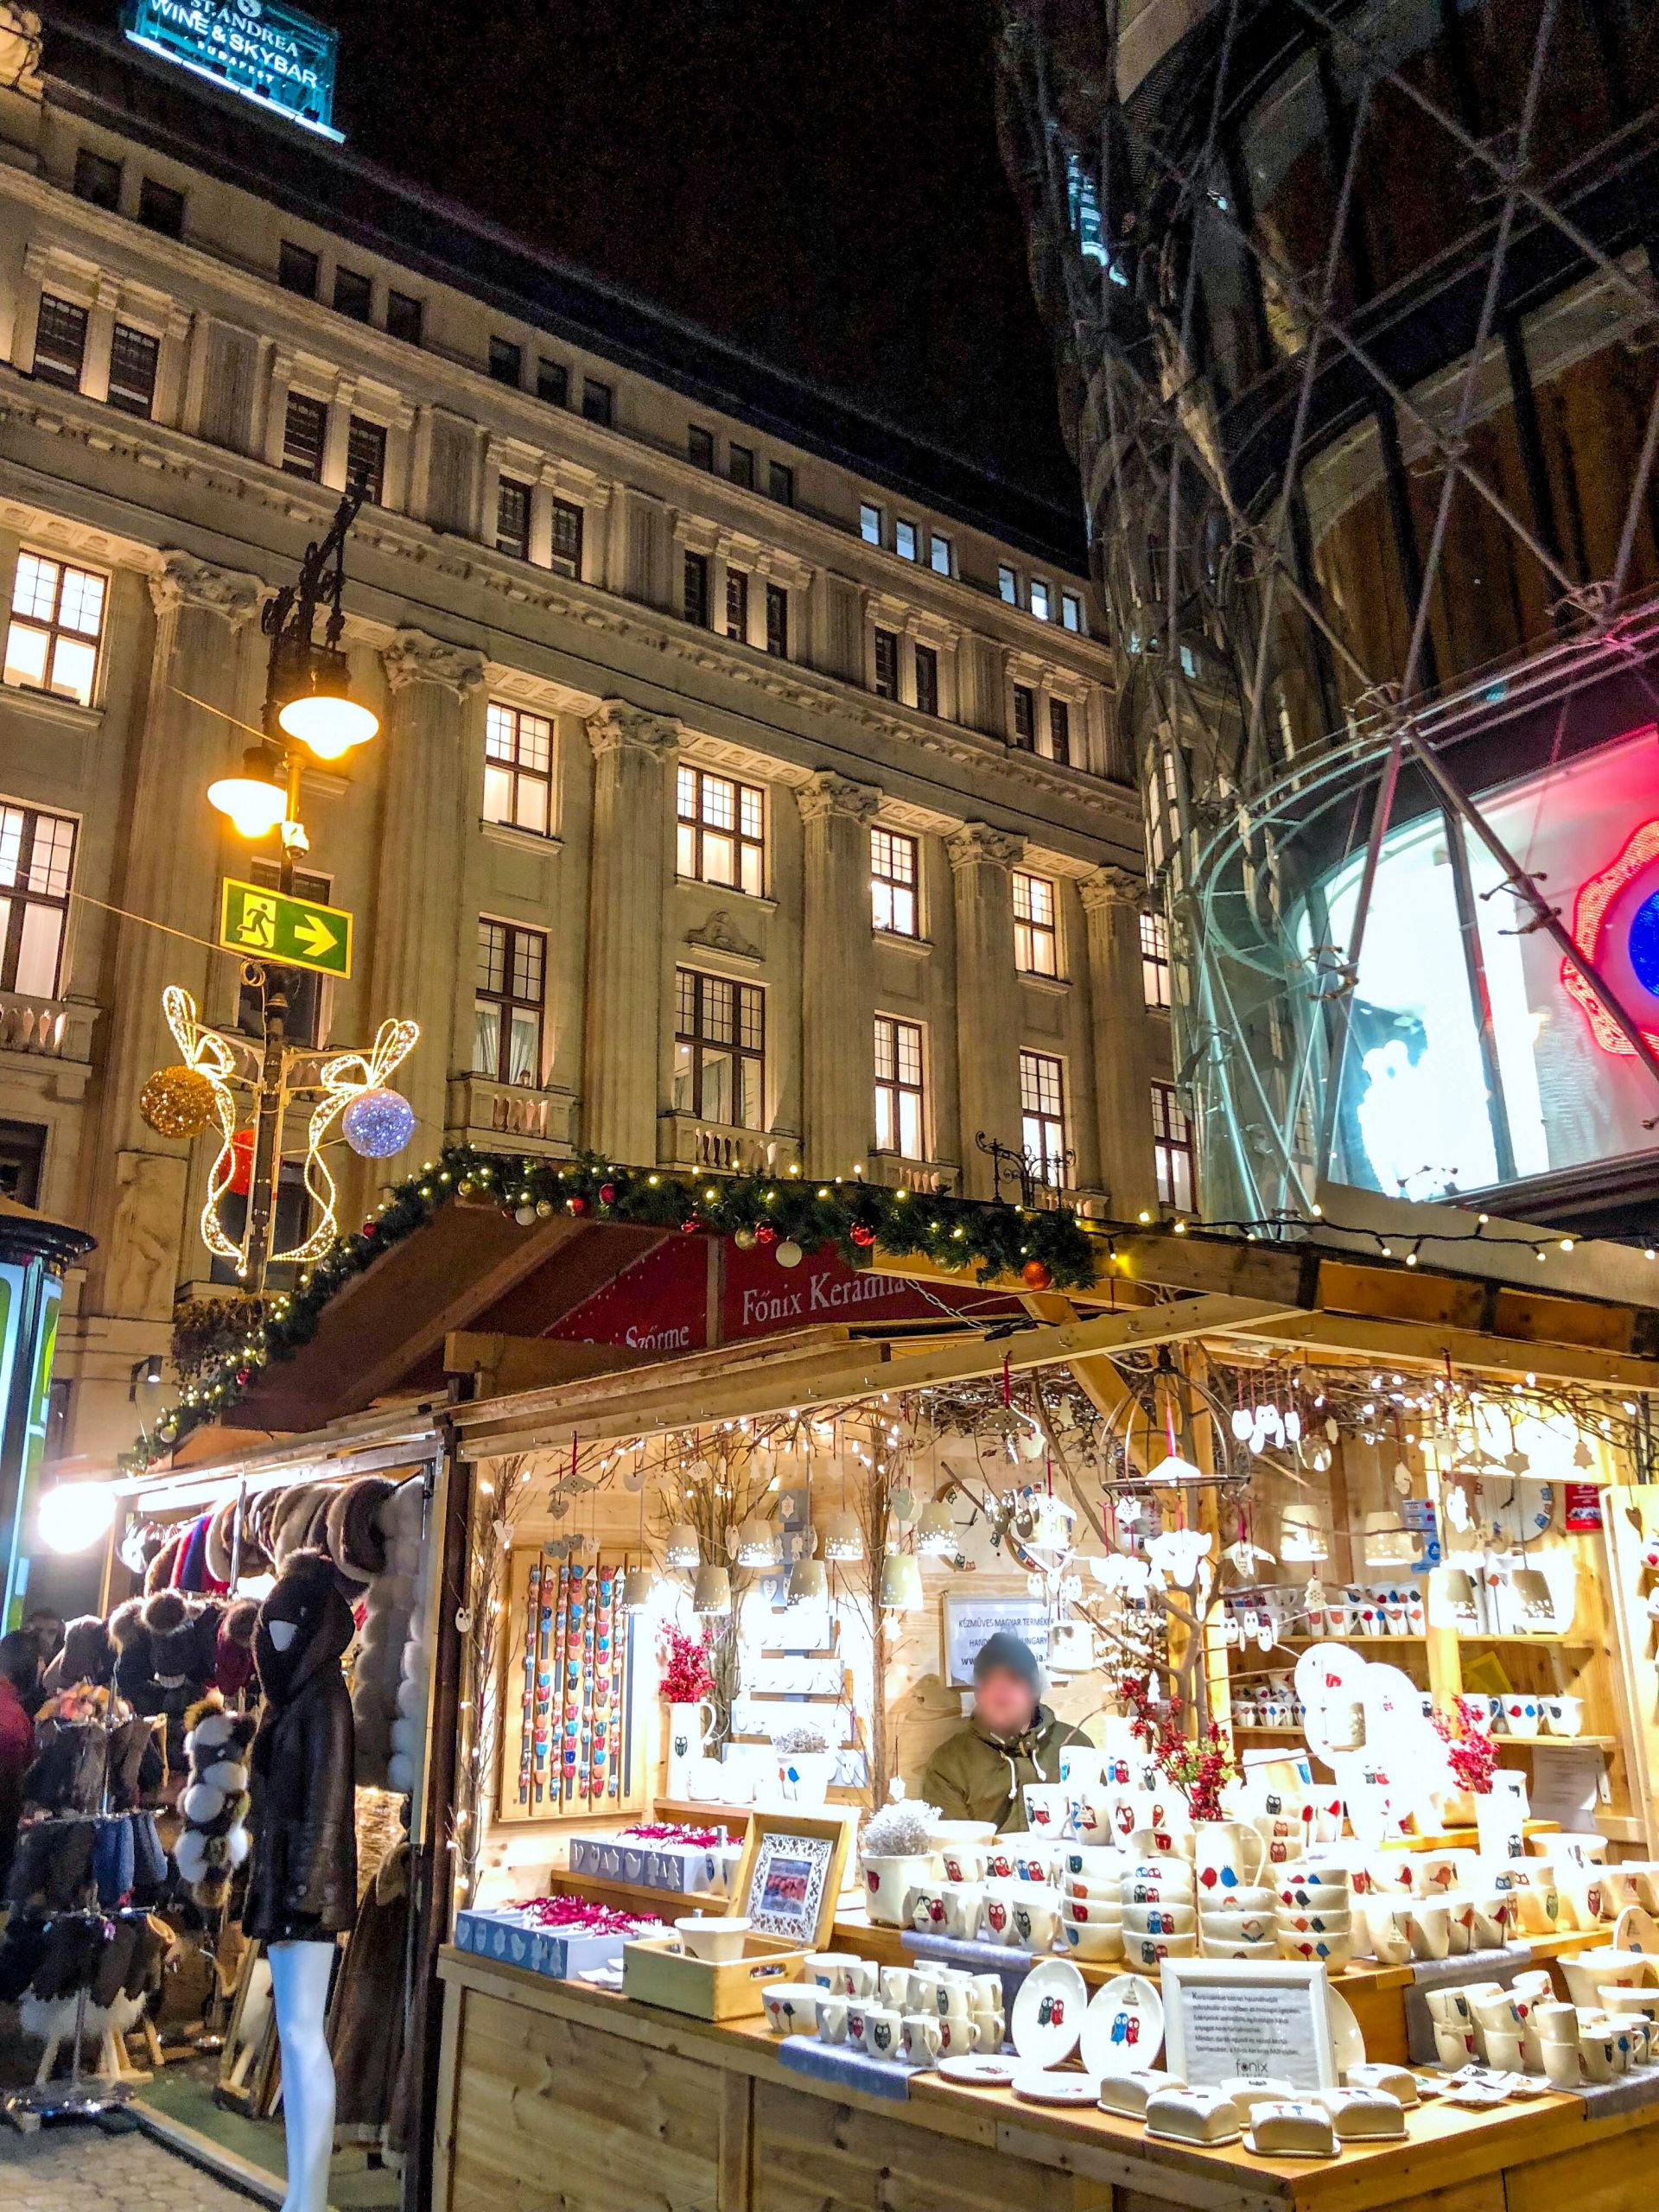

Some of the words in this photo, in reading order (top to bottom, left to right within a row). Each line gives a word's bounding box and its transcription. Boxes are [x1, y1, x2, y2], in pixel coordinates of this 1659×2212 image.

[150, 0, 210, 35] WINE
[211, 24, 226, 43] &
[229, 33, 317, 88] SKYBAR
[217, 8, 298, 57] ANDREA
[197, 40, 275, 84] BUDAPEST
[742, 1289, 802, 1325] Főnix
[958, 1618, 994, 1628] KÉZMŰVES
[995, 1618, 1021, 1628] MAGYAR
